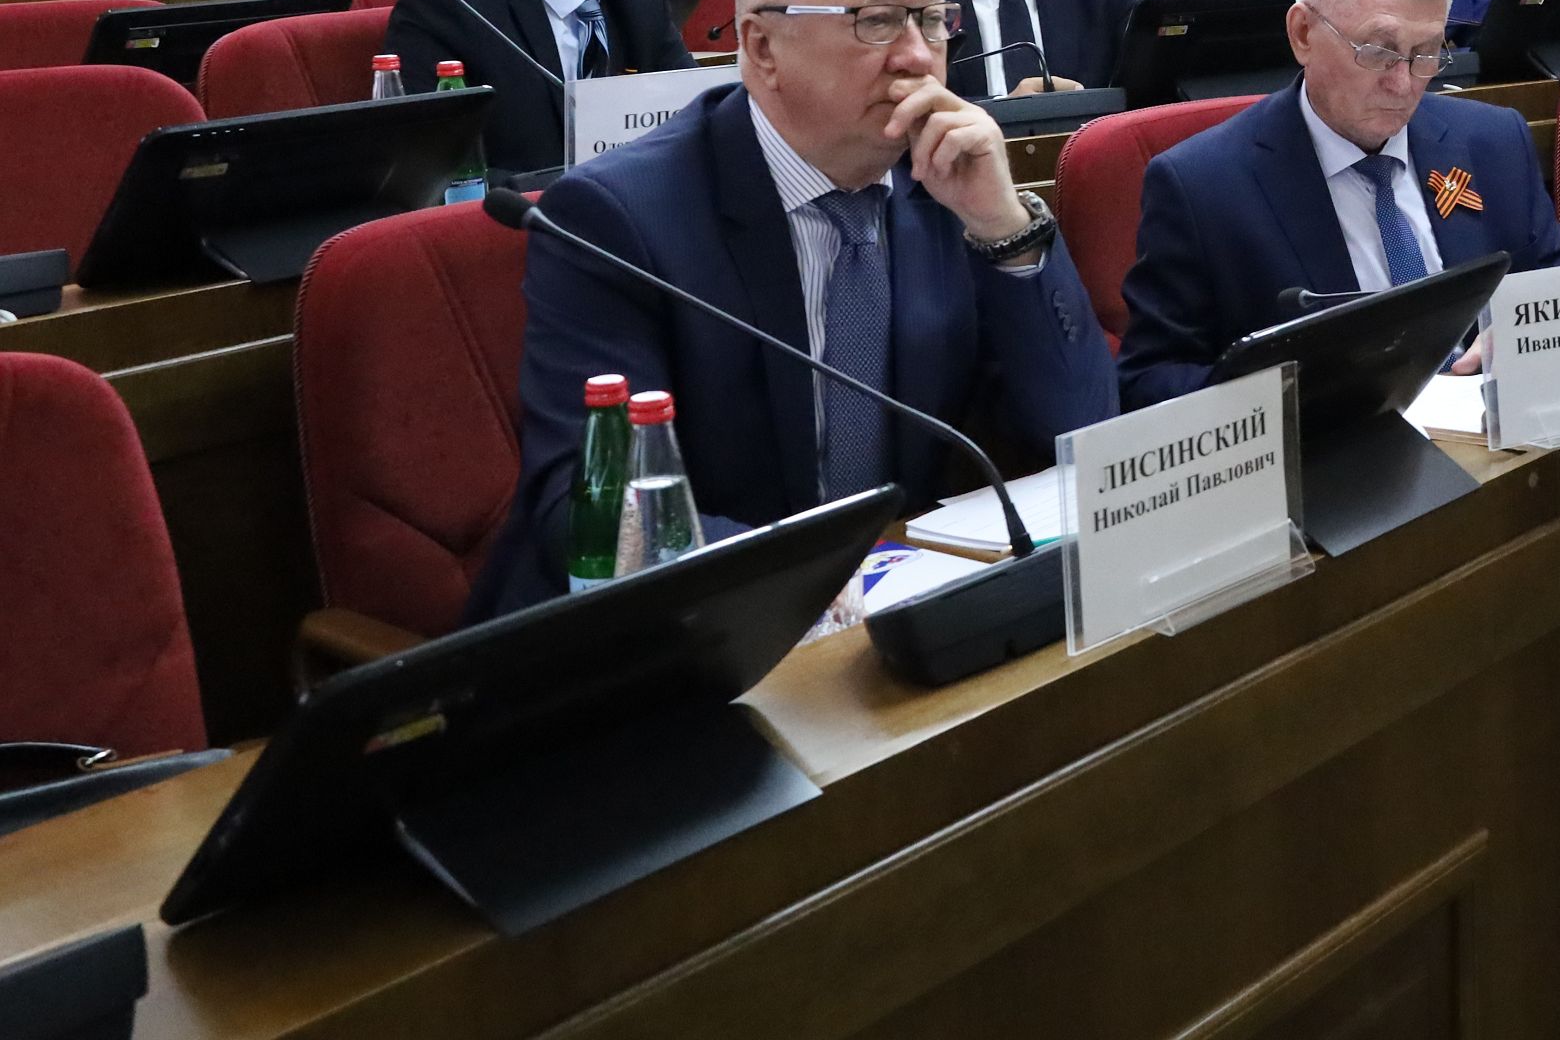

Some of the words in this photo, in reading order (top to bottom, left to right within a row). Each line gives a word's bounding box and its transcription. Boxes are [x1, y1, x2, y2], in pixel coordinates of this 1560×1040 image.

[624, 109, 681, 130] ПОП
[1098, 406, 1268, 494] ЛИСИНСКИЙ
[1093, 482, 1181, 534] Николай
[1186, 451, 1276, 498] Павлович
